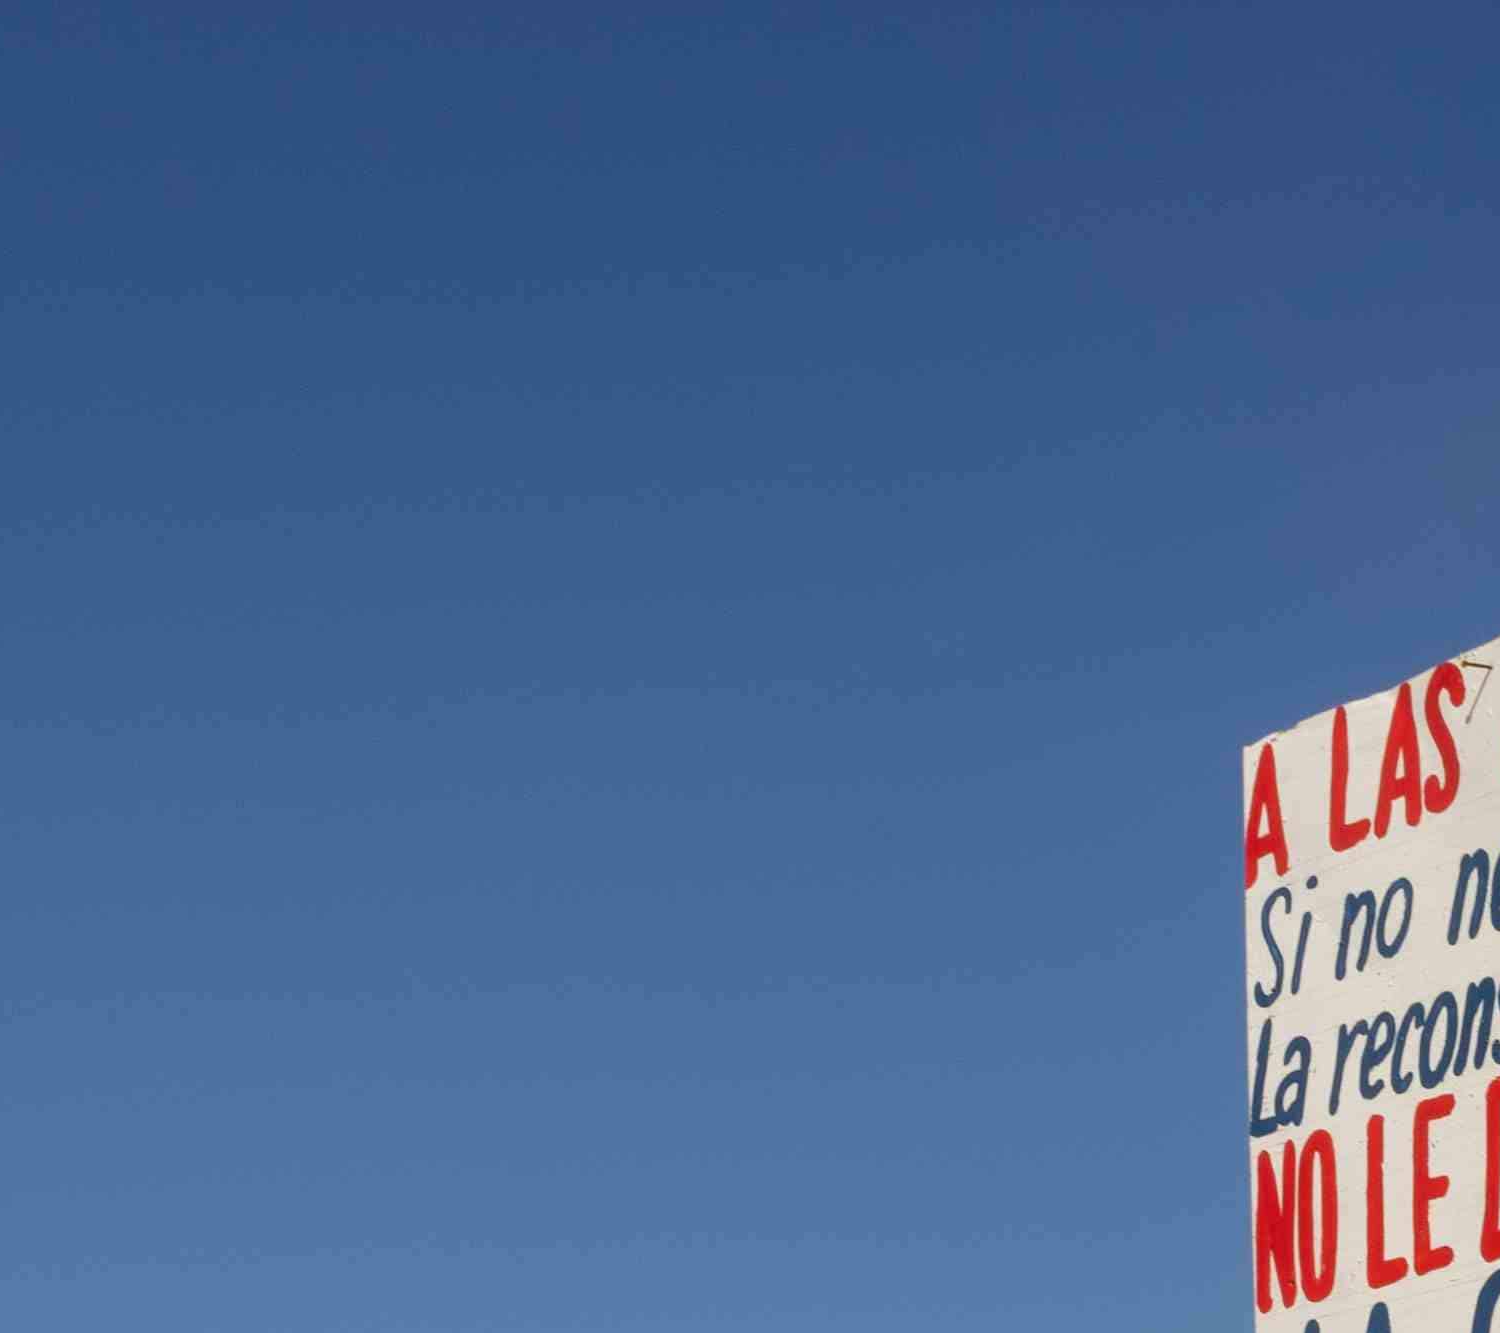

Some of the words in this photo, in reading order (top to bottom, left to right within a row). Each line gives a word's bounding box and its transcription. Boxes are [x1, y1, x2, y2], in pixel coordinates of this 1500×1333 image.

[1243, 741, 1290, 890] A
[1329, 661, 1466, 854] LAS
[1254, 873, 1319, 1008] Si
[1334, 878, 1413, 980] no
[1249, 1015, 1309, 1138] La
[1254, 1128, 1339, 1314] NO
[1365, 1092, 1457, 1289] LE
